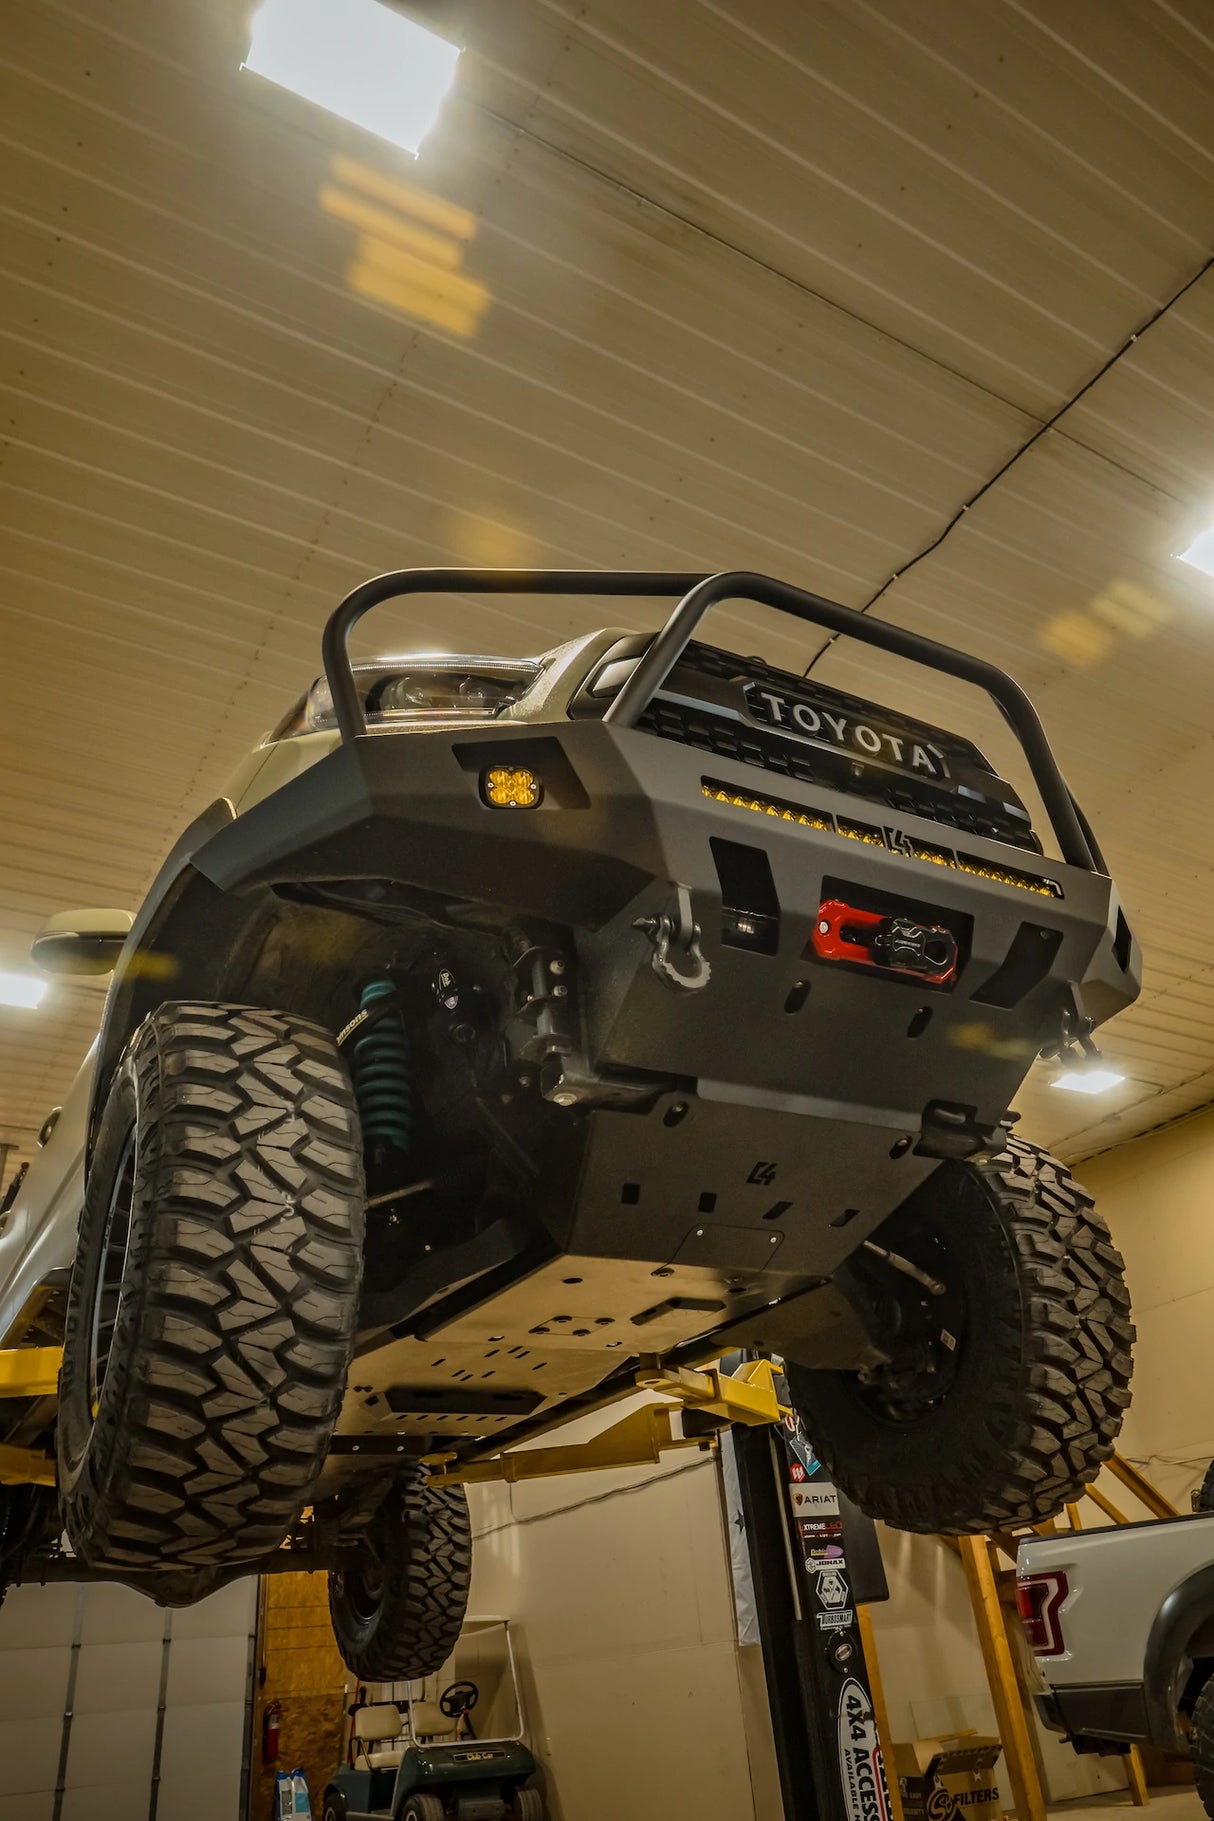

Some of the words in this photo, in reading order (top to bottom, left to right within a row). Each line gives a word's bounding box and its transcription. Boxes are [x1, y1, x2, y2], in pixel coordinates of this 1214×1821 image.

[761, 692, 936, 775] TOYOTA
[804, 1495, 836, 1504] ARIAT
[846, 1695, 867, 1741] 4X4
[844, 1748, 860, 1810] AVAILABLE
[953, 1787, 999, 1806] FILTERS
